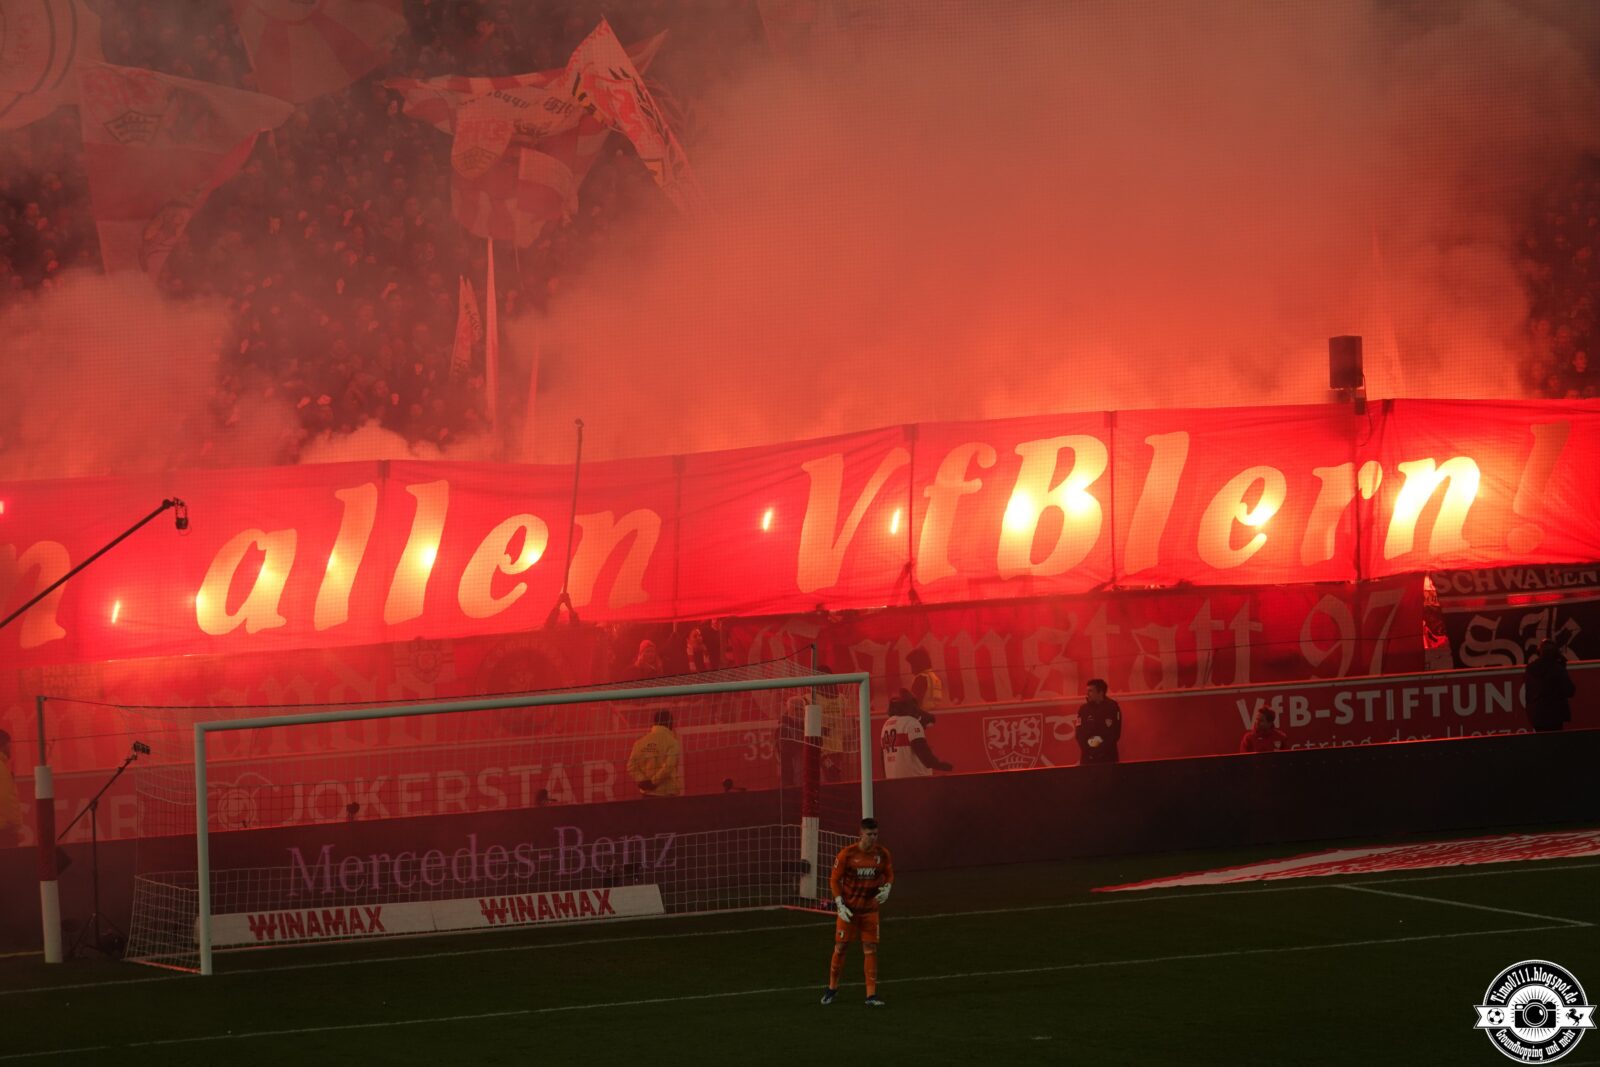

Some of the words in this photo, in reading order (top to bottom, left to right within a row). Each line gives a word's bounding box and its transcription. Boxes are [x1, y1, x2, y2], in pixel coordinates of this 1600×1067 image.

[195, 480, 662, 635] allen
[797, 423, 1571, 593] VfBlern!
[1299, 588, 1407, 685] 97
[1236, 681, 1527, 730] VfB-STIFTUN
[282, 760, 616, 824] JOKERSTAR
[286, 826, 677, 897] Mercedes-Benz
[857, 867, 876, 876] WWK
[248, 906, 386, 941] WINAMAX
[479, 889, 616, 924] WINAMAX
